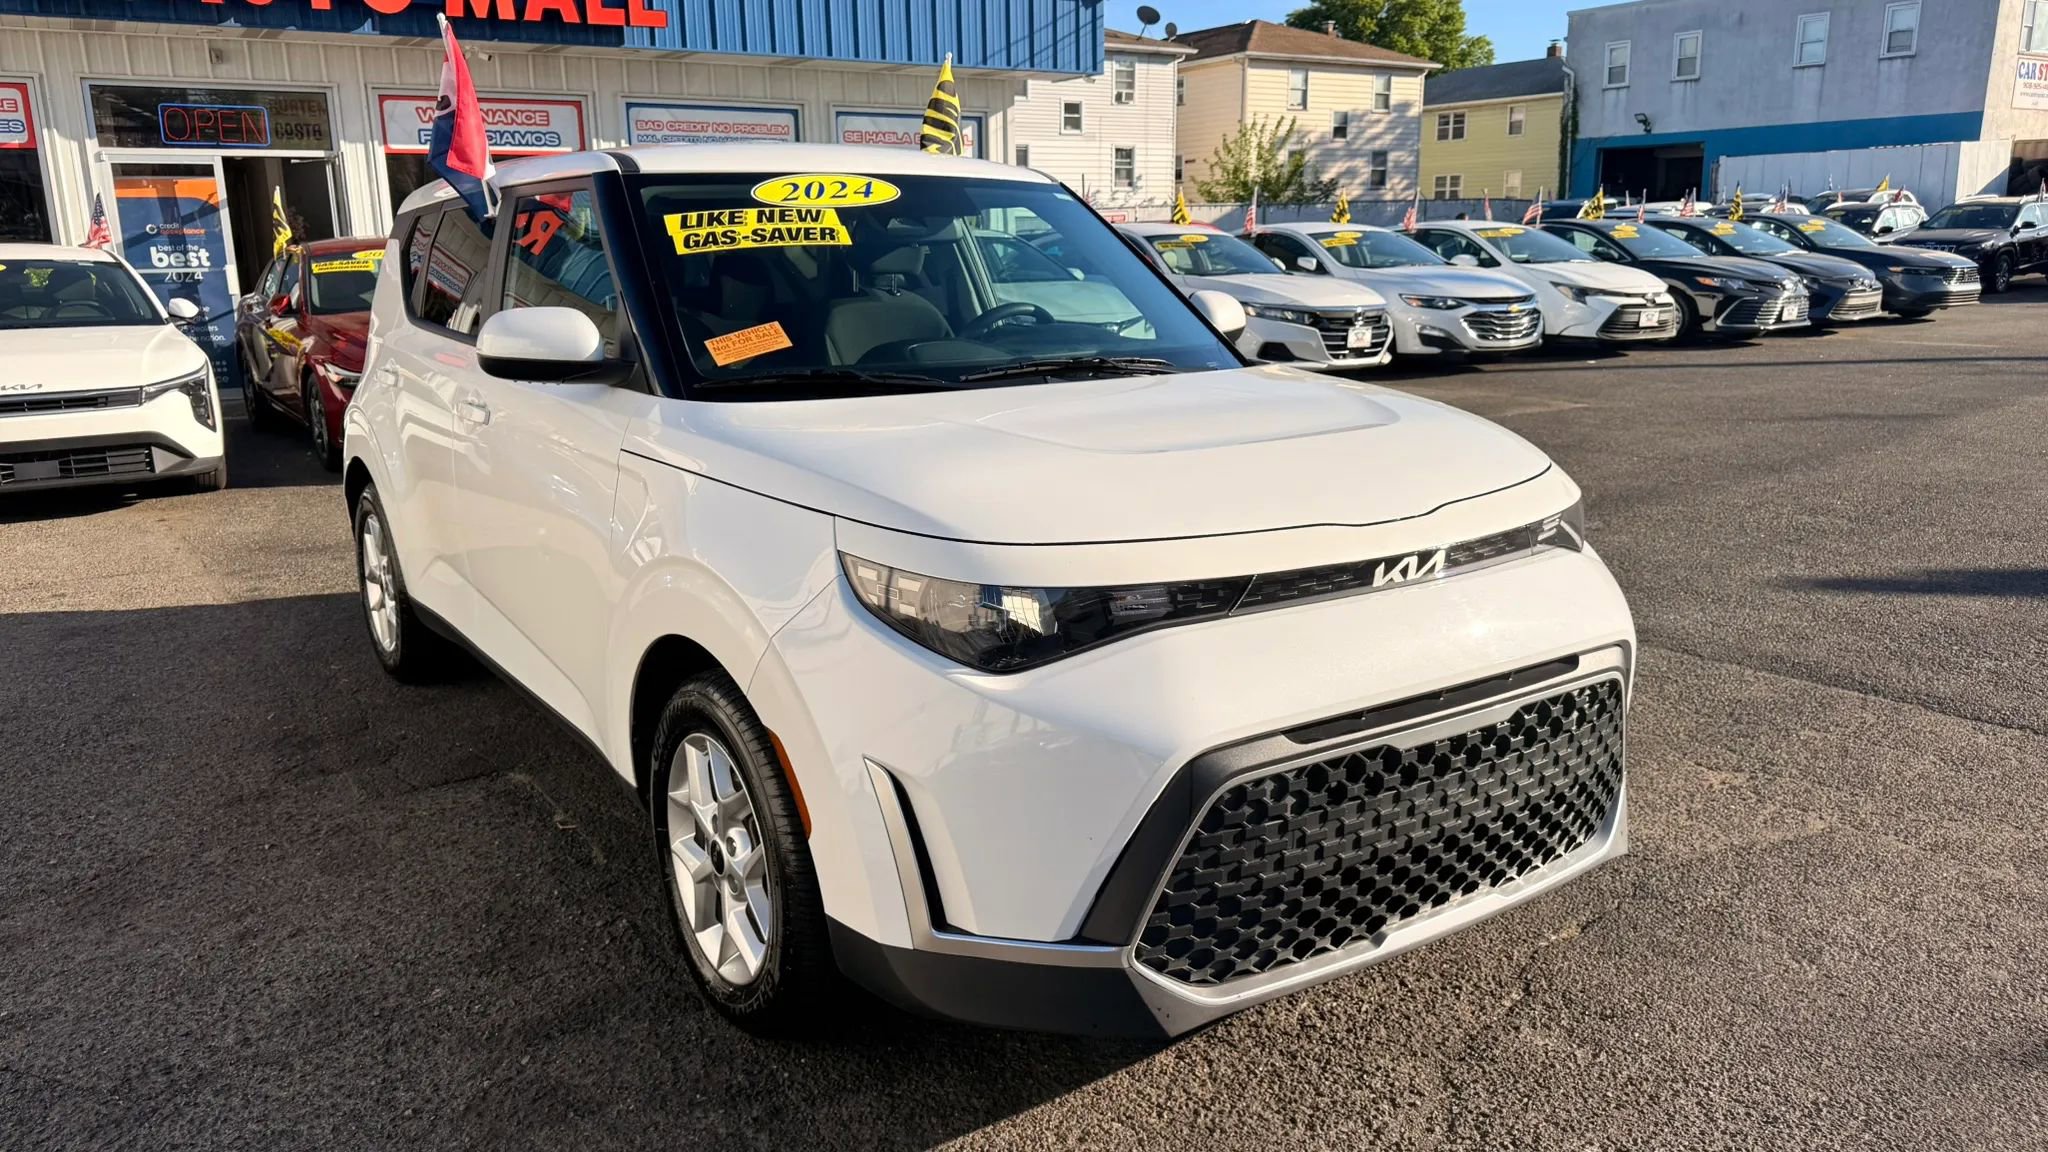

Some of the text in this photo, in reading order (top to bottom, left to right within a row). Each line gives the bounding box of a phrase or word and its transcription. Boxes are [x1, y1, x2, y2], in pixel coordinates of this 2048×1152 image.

[2019, 62, 2036, 80] CAR
[163, 107, 266, 143] OPEN
[636, 120, 790, 136] BAD CREDIT NO PROBLEM
[843, 130, 864, 144] SE
[865, 130, 912, 145] HABLA
[780, 180, 874, 202] 2024
[679, 208, 826, 230] LIKE NEW
[683, 226, 840, 250] GAS-SAVER
[150, 246, 210, 267] best
[164, 272, 203, 282] 2024
[731, 336, 753, 347] FOR
[1372, 550, 1446, 588] KIA
